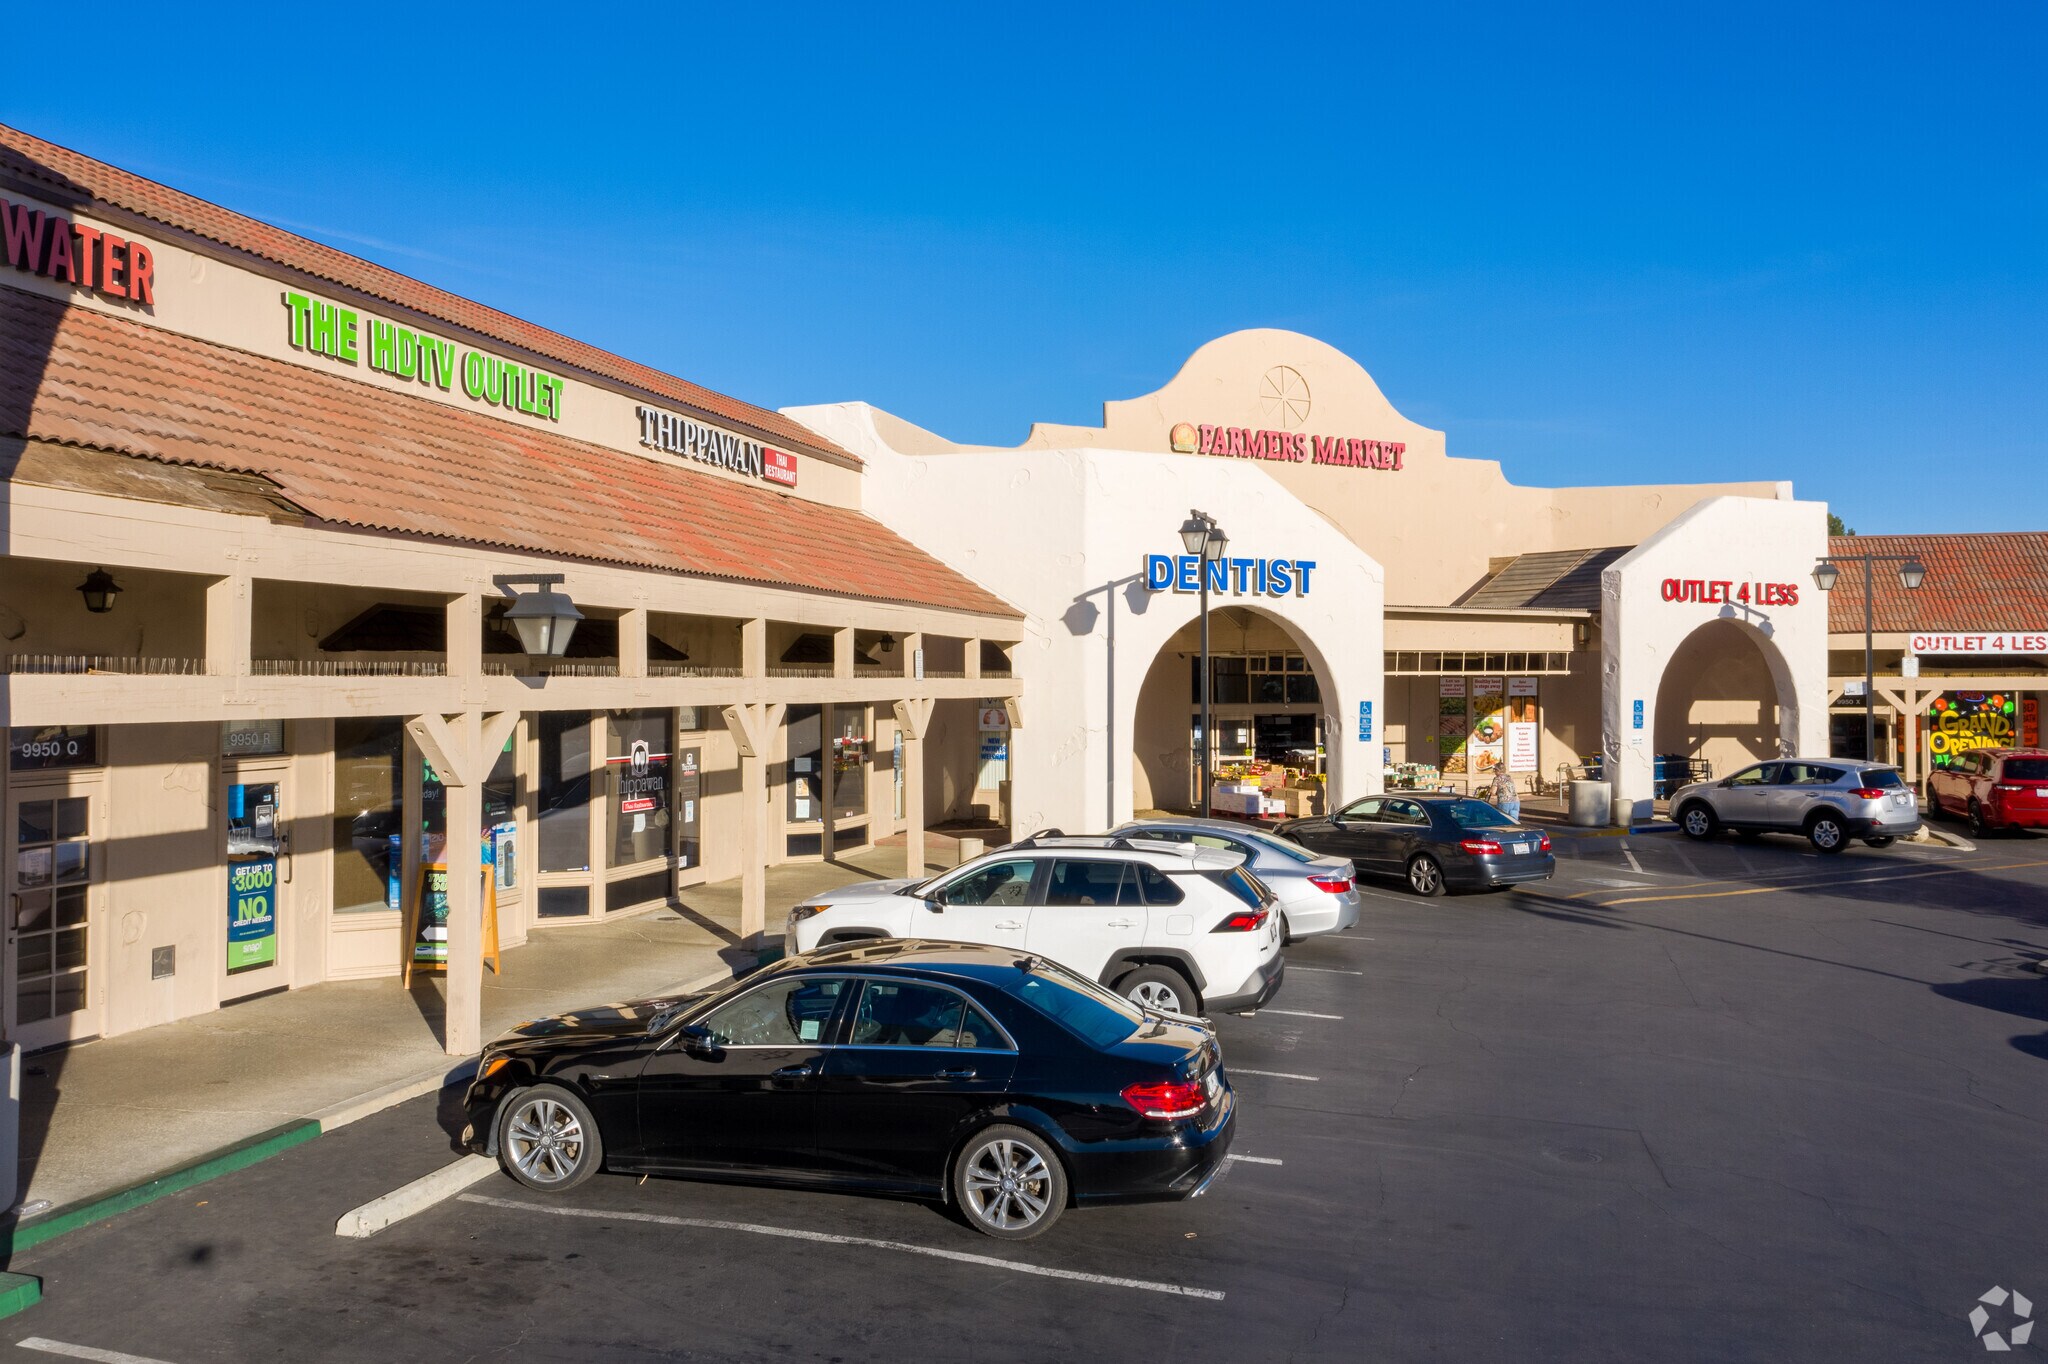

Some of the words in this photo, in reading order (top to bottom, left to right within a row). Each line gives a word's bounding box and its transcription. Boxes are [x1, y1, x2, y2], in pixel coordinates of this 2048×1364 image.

[0, 198, 154, 305] WATER
[286, 291, 359, 362] THE
[371, 319, 456, 389] HDTV
[464, 351, 564, 420] OUTLET
[640, 405, 764, 479] THIPPAWAN
[1199, 423, 1308, 462] FARMERS
[1313, 435, 1406, 470] MARKET
[775, 453, 788, 468] THAI
[765, 463, 796, 484] RESTAURANT
[1147, 554, 1317, 595] DENTIST
[1661, 578, 1733, 603] OUTLET
[1737, 582, 1751, 604] 4
[1755, 582, 1799, 606] LESS
[1913, 636, 1987, 651] OUTLET
[1992, 636, 2005, 651] 4
[2011, 636, 2048, 651] LES
[1939, 710, 2010, 739] GRAND
[22, 742, 60, 758] 9950
[67, 741, 78, 755] Q
[230, 733, 259, 747] 9950
[263, 732, 271, 745] R
[422, 788, 439, 800] day!
[614, 774, 663, 800] Thippawan
[235, 866, 251, 876] GET
[251, 865, 262, 874] UP
[263, 863, 273, 872] TO
[232, 871, 273, 892] $3,000
[238, 895, 268, 922] NO
[233, 919, 251, 928] CREDIT
[251, 915, 272, 925] NEEDED
